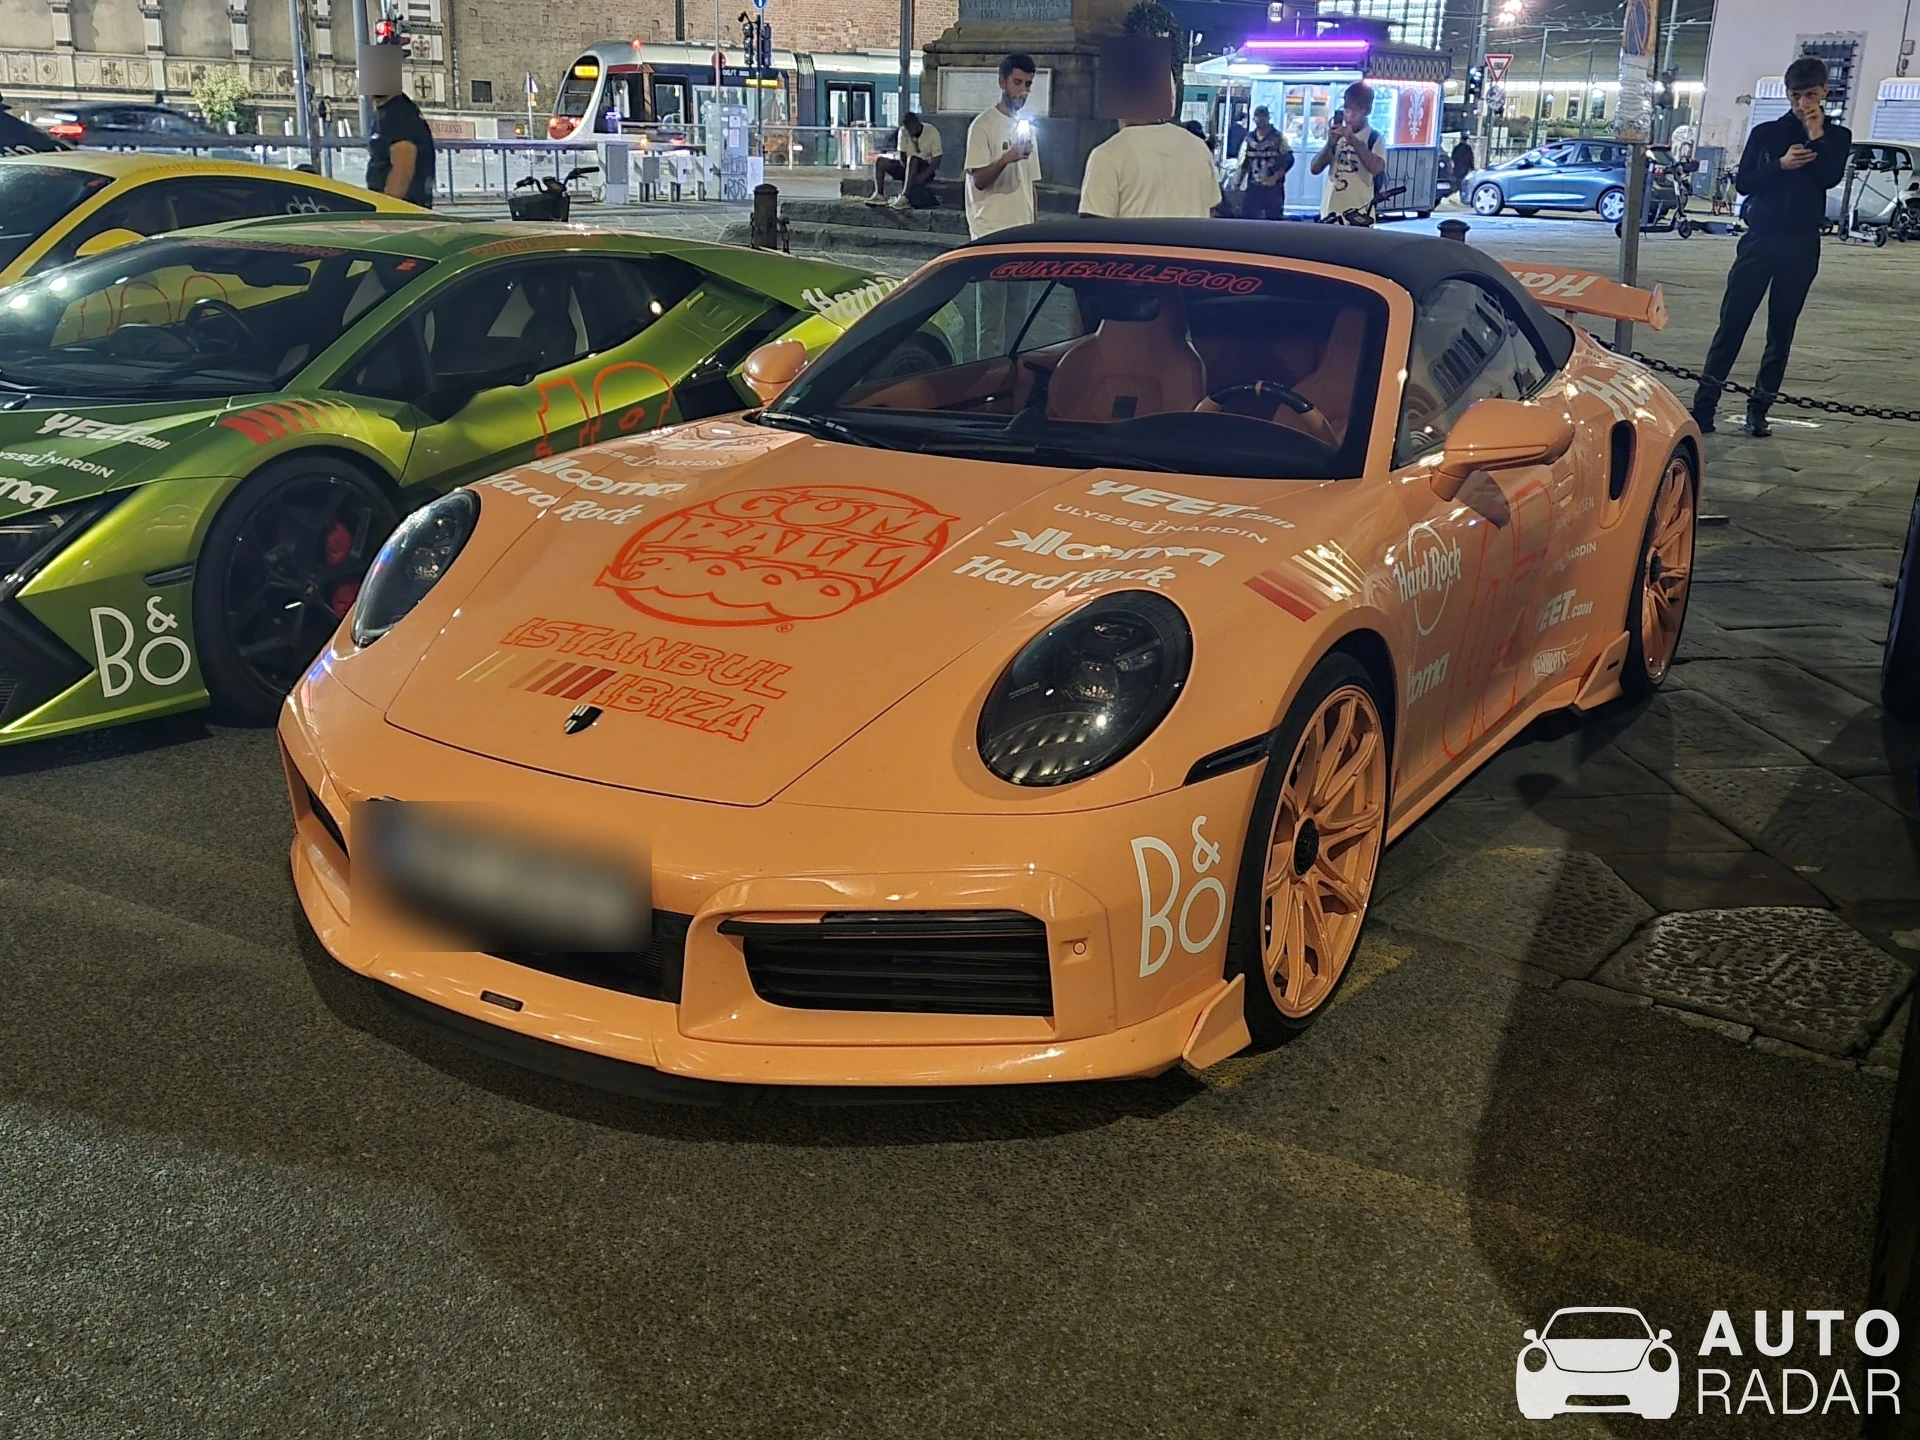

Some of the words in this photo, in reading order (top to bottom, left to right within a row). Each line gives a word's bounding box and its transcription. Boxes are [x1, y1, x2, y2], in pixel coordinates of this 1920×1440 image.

[990, 261, 1261, 294] GUMBALL3000
[36, 413, 170, 450] YEET.com
[48, 455, 115, 479] NARDIN
[552, 500, 645, 525] Rock
[1053, 503, 1146, 529] ULYSSE
[1164, 525, 1269, 545] NARDIN
[1085, 479, 1297, 530] YEET.com
[952, 555, 1078, 591] Hard
[1066, 566, 1177, 588] Rock
[1393, 550, 1429, 603] Hard
[1428, 536, 1462, 591] Rock
[499, 617, 793, 700] ISTANBUL
[592, 673, 766, 743] IBIZA
